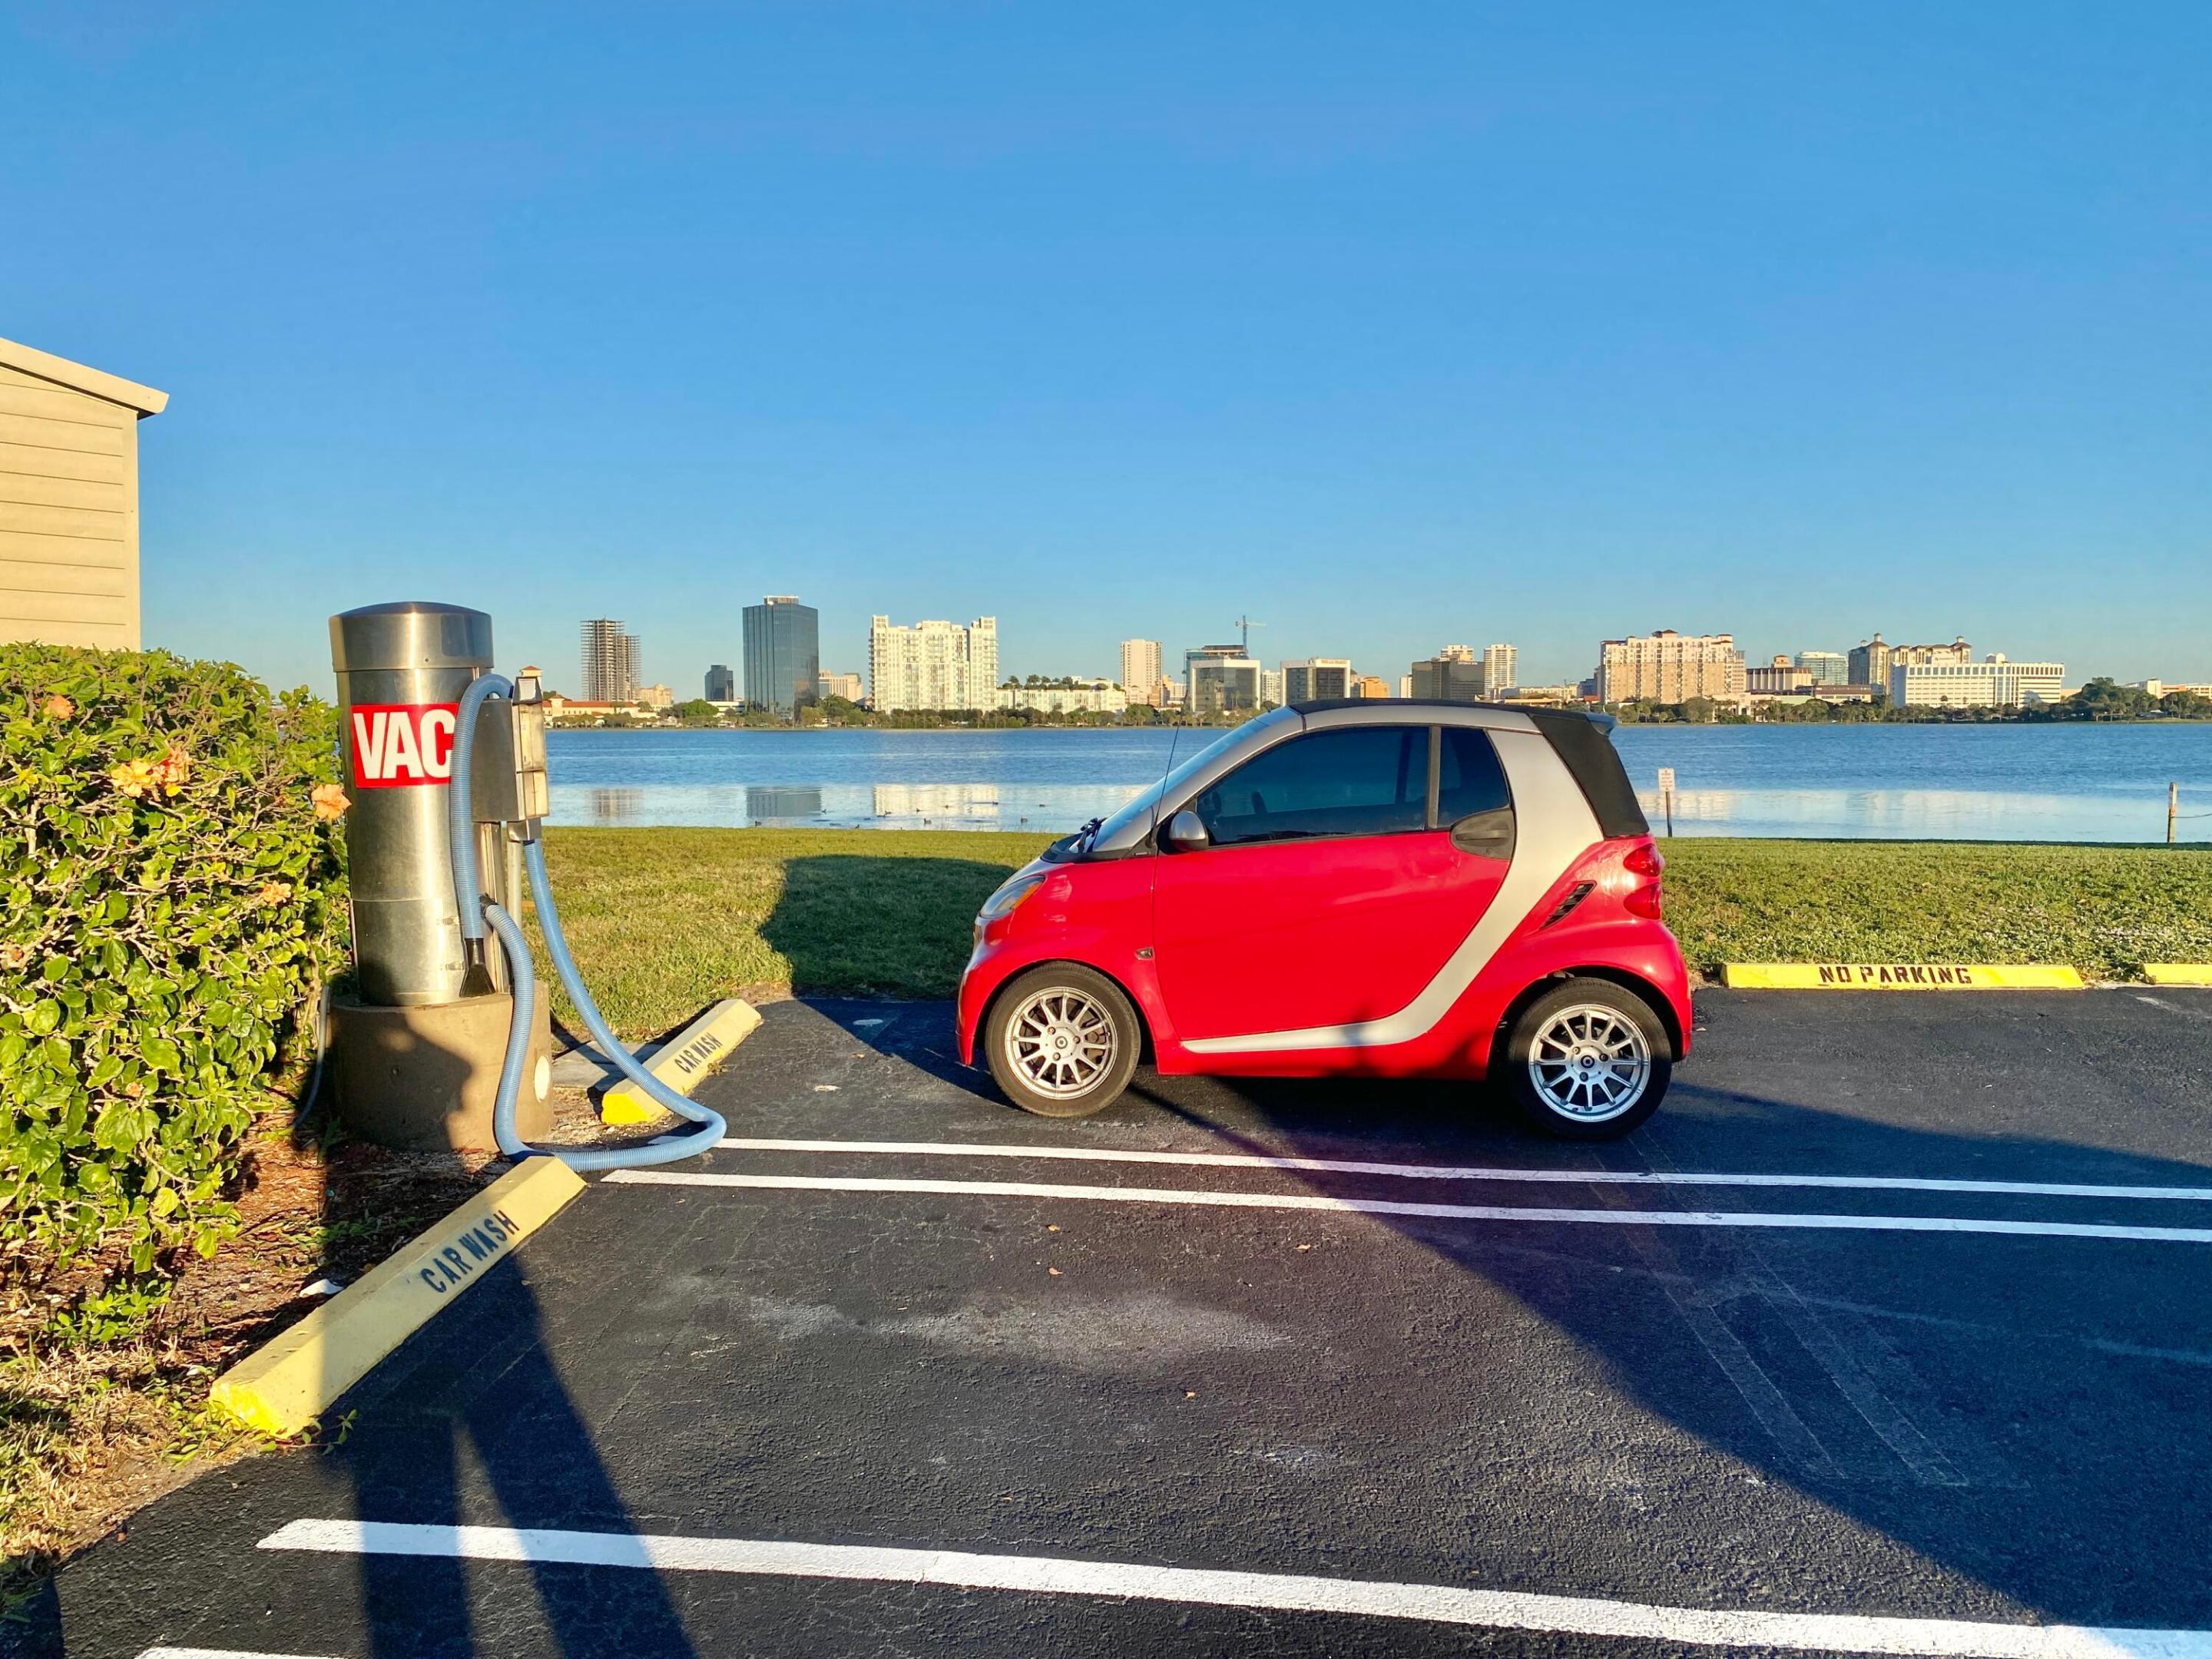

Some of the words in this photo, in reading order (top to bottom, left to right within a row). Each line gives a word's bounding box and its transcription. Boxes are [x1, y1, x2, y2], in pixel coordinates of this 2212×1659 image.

[353, 709, 455, 779] VAC
[1819, 966, 1852, 982] NO
[1859, 966, 1972, 984] PARKING
[674, 1049, 702, 1074] CAR
[690, 1031, 723, 1059] WASH
[419, 1247, 473, 1293] CAR
[459, 1210, 520, 1261] WASH
